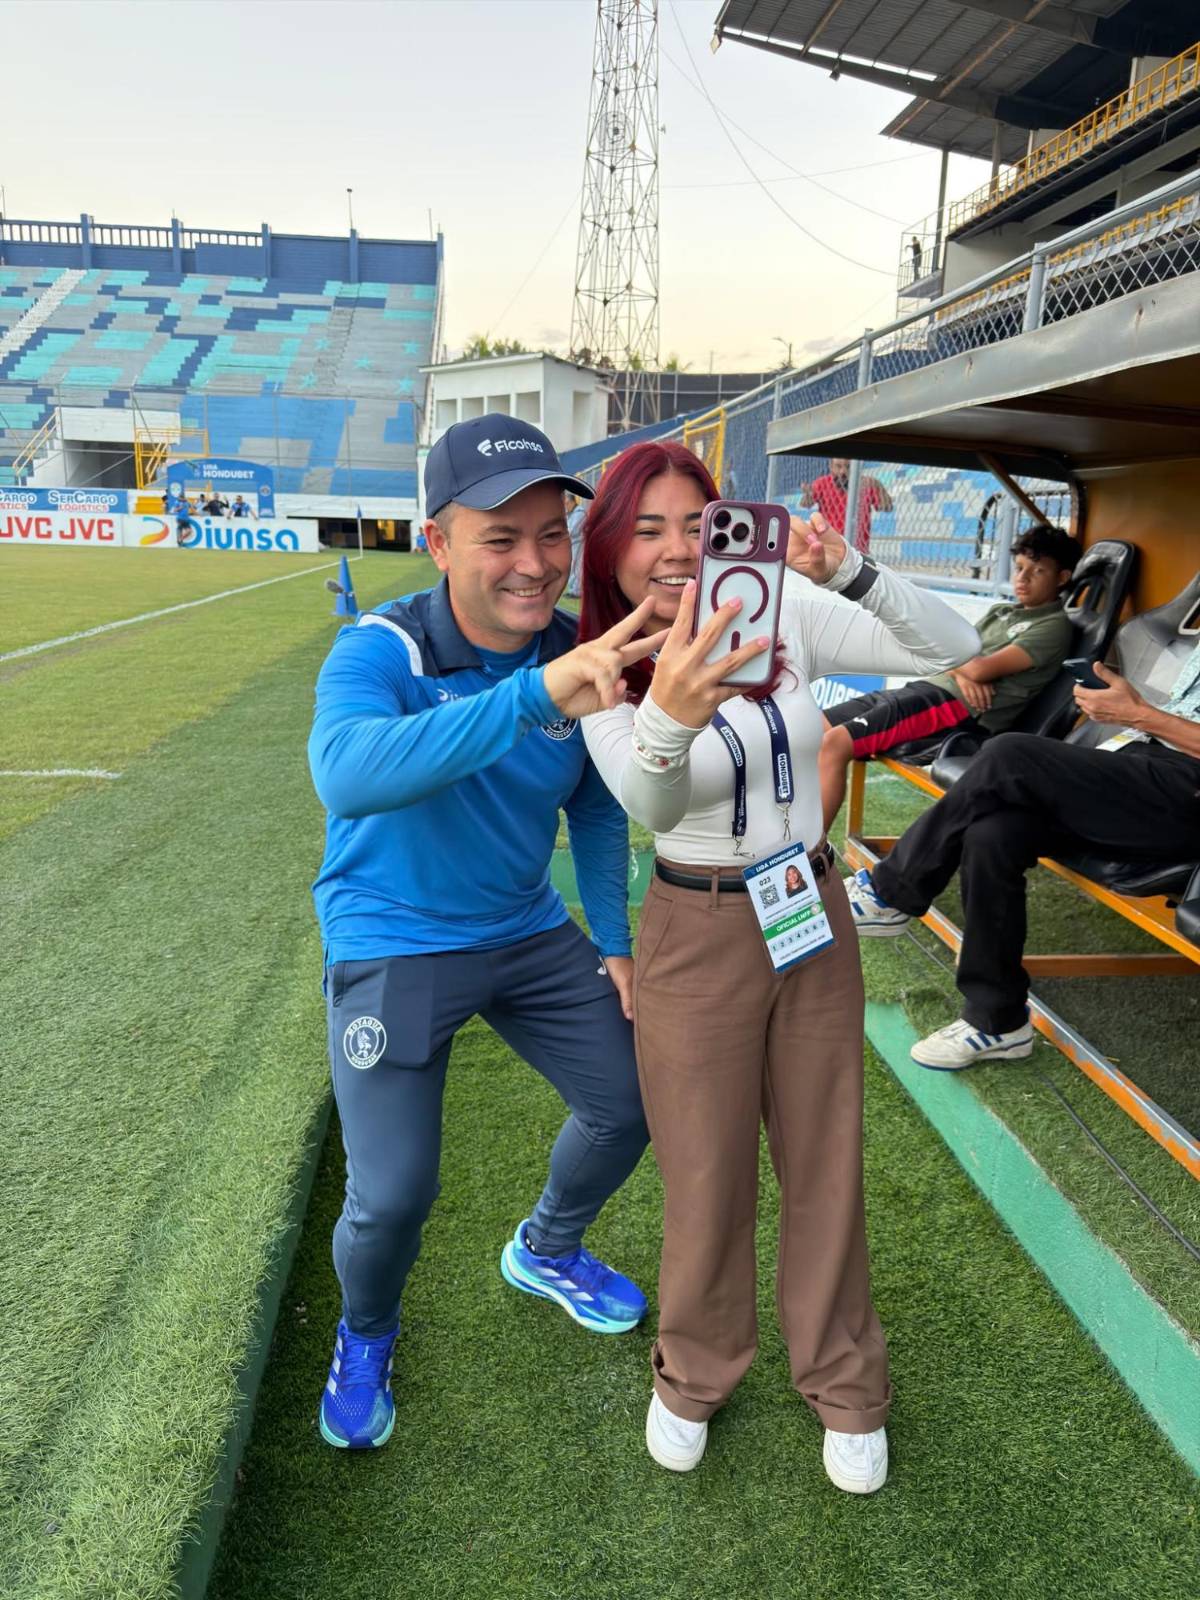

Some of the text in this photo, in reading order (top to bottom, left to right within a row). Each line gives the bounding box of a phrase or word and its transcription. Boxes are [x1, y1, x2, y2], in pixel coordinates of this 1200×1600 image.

[494, 438, 544, 453] Ficohsa
[203, 470, 255, 479] HONDUBET
[60, 504, 109, 513] LOGISTICS
[0, 516, 52, 538] JVC
[59, 518, 114, 540] JVC
[177, 515, 300, 551] Diunsa
[779, 754, 789, 794] HONDUBET
[769, 847, 799, 867] HONDUBET
[776, 916, 798, 932] OFICIAL
